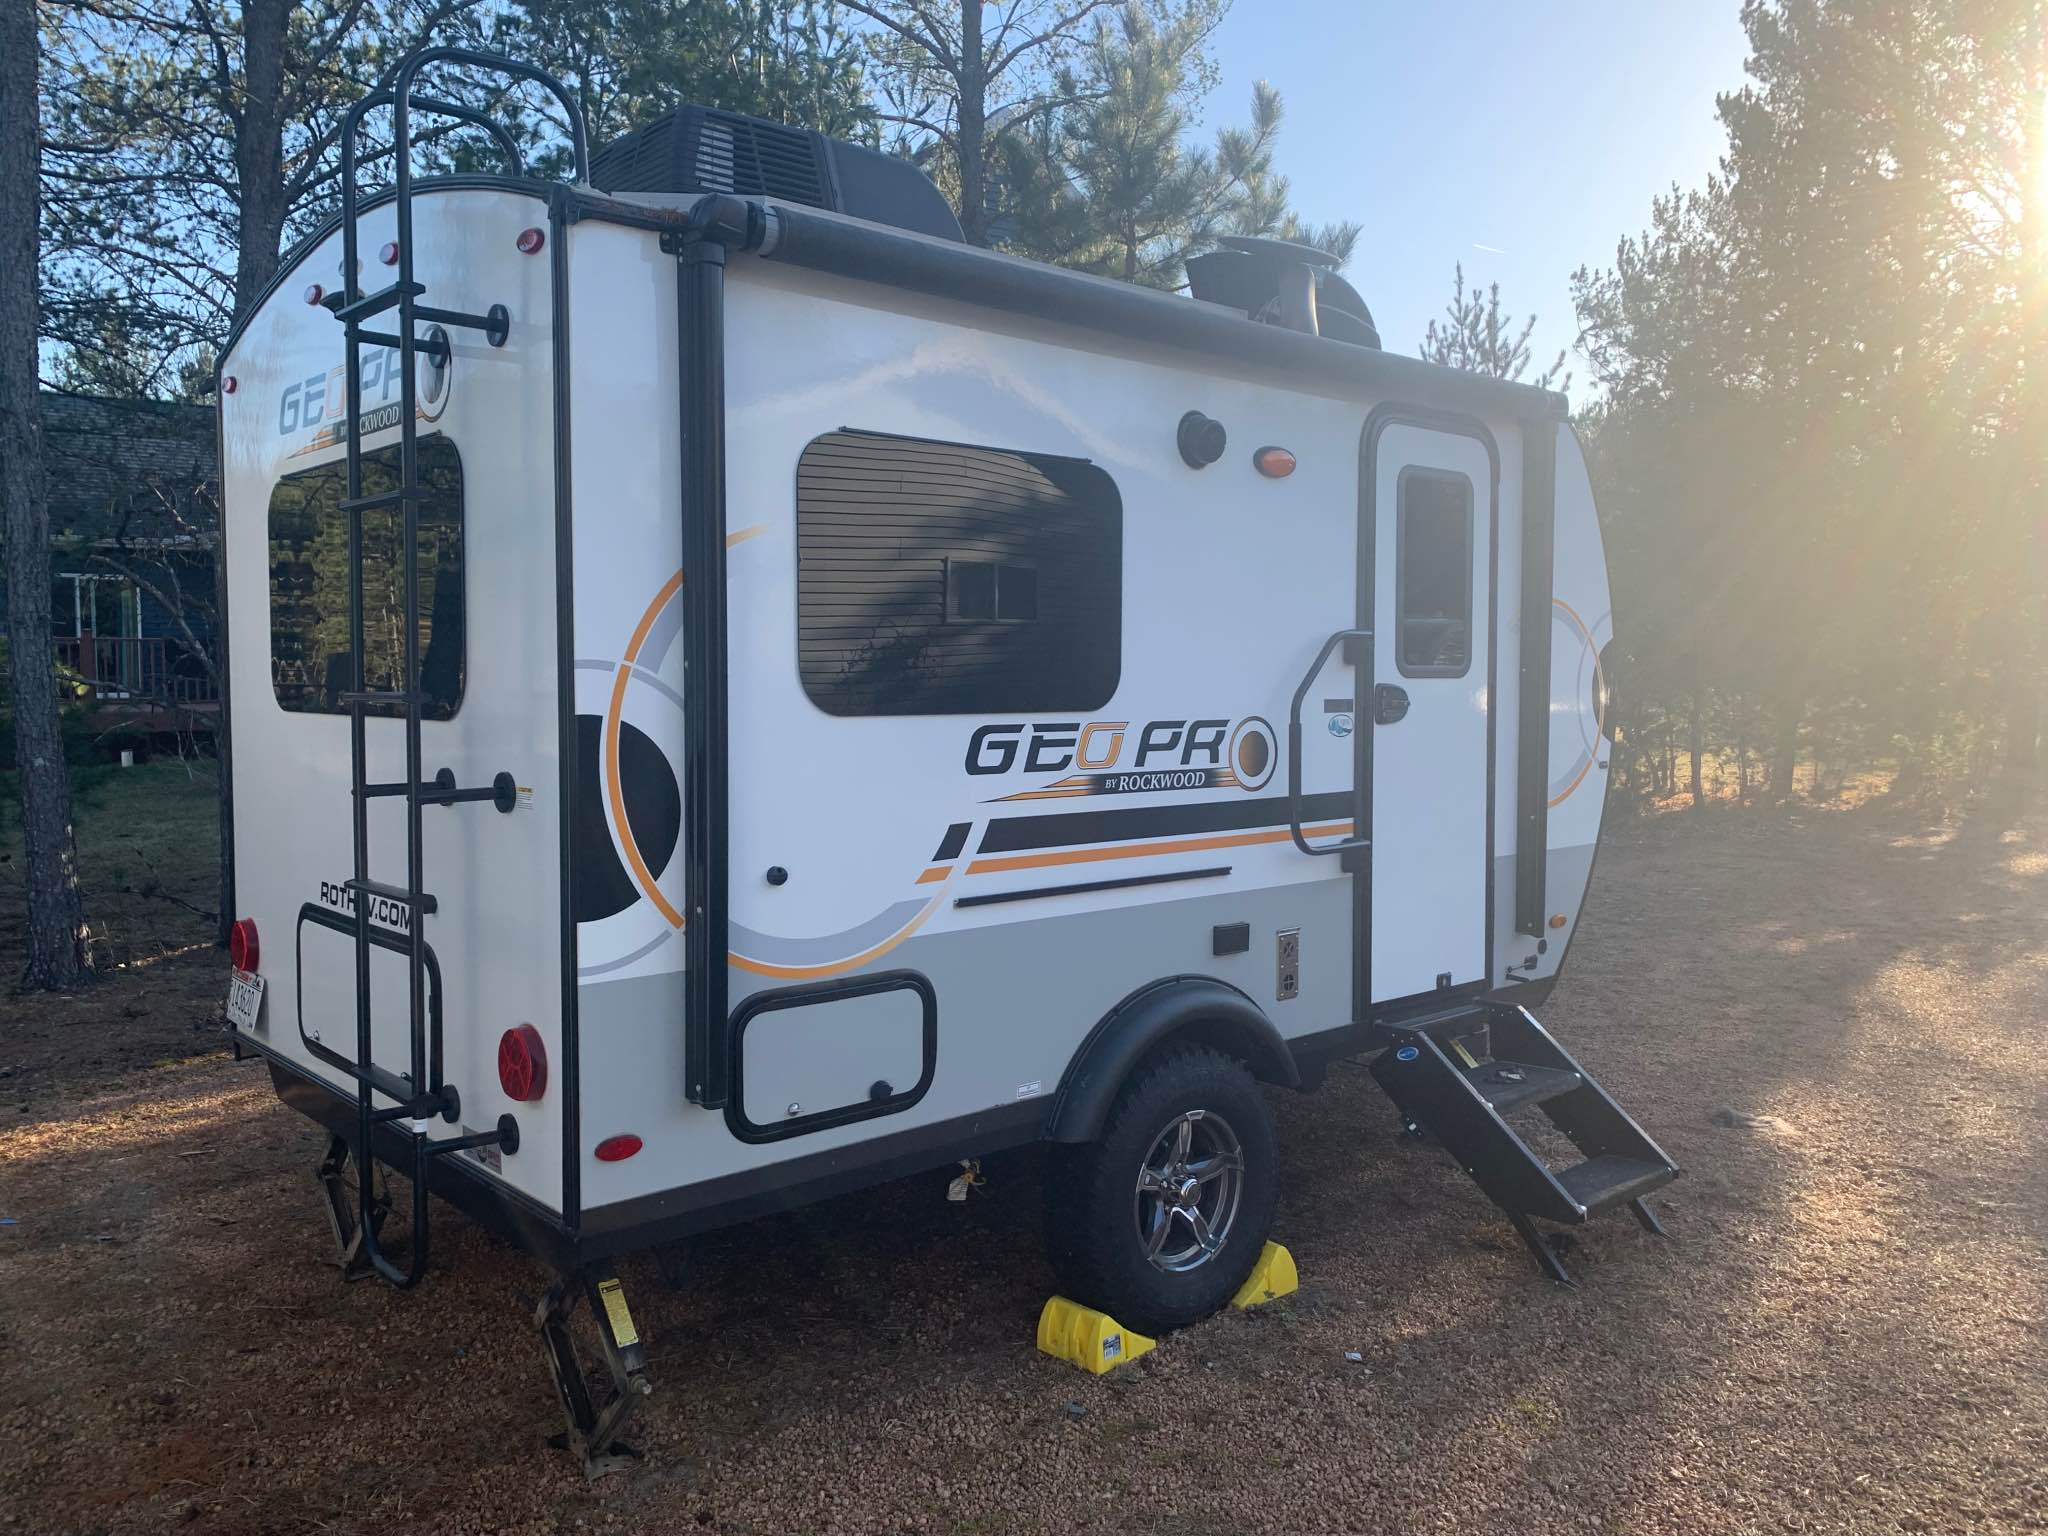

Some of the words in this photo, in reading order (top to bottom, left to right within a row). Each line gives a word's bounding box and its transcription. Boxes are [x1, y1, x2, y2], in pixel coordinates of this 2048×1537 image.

[279, 363, 347, 435] GEO
[360, 406, 399, 434] CKWOOD
[965, 722, 1129, 776] GEO
[1134, 716, 1278, 792] PRO
[1105, 778, 1118, 790] BY
[1119, 771, 1206, 791] ROCKWOOD
[320, 881, 410, 930] ROTHV.COM
